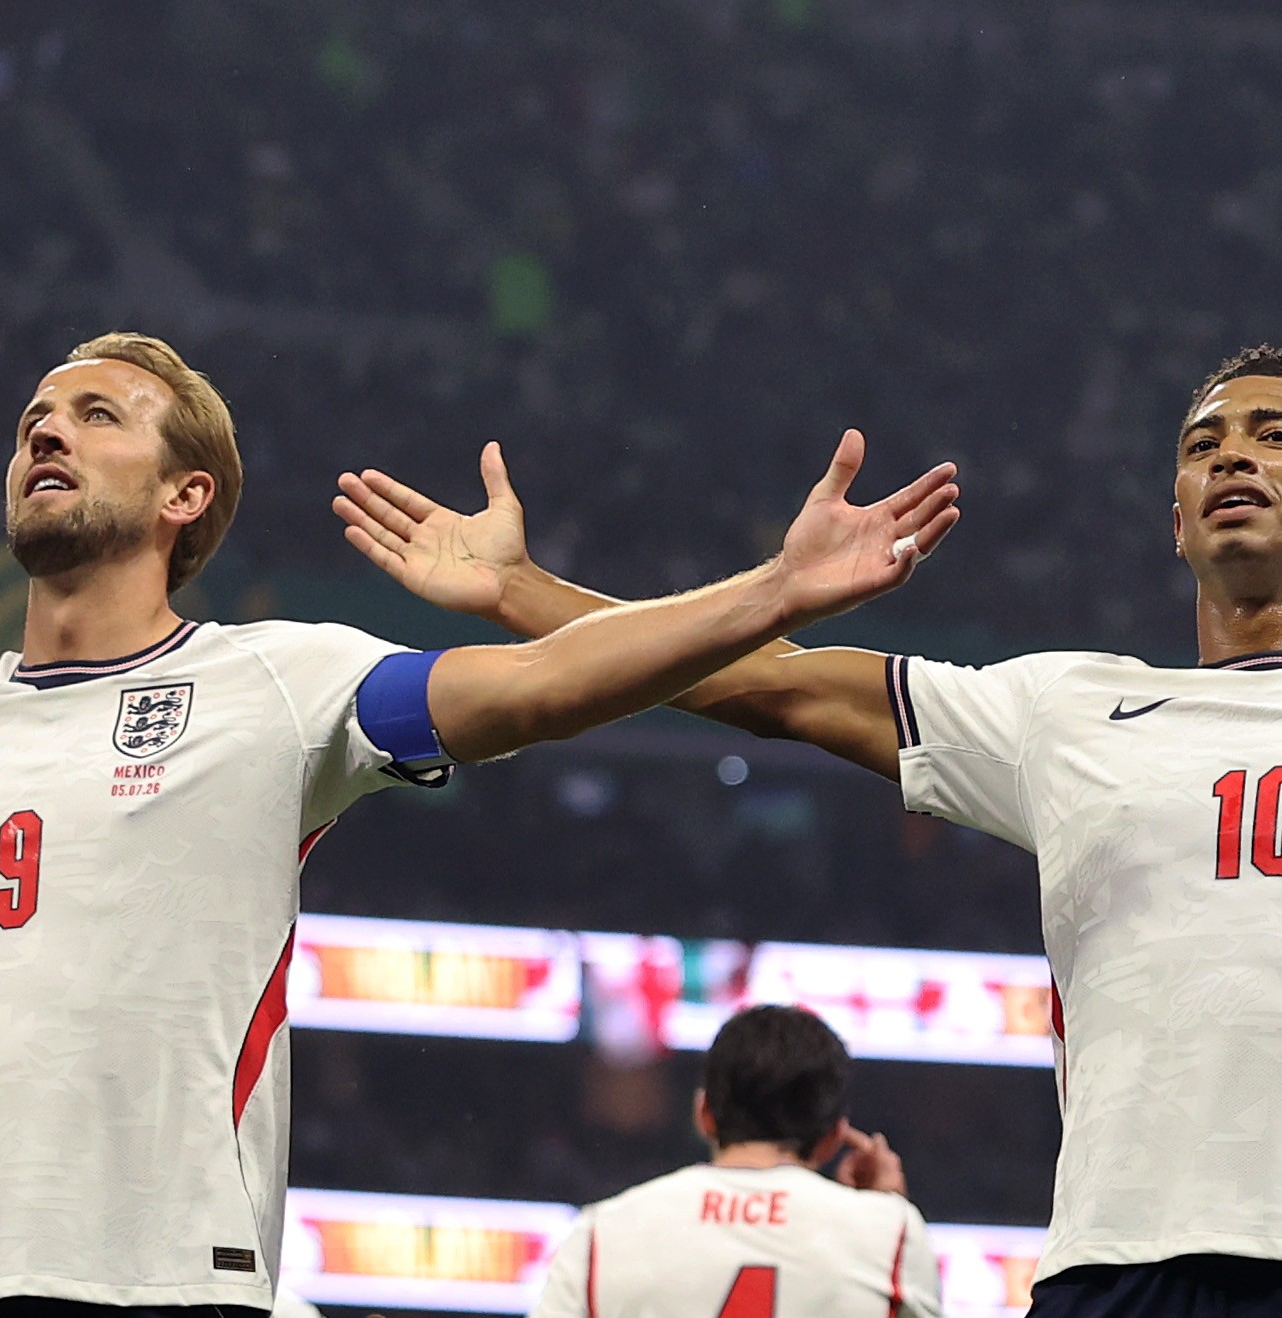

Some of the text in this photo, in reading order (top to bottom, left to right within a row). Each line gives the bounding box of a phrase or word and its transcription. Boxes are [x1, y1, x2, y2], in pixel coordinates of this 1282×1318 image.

[114, 765, 165, 778] MEXICO
[111, 783, 160, 796] 05.07.26
[700, 1190, 790, 1226] RICE
